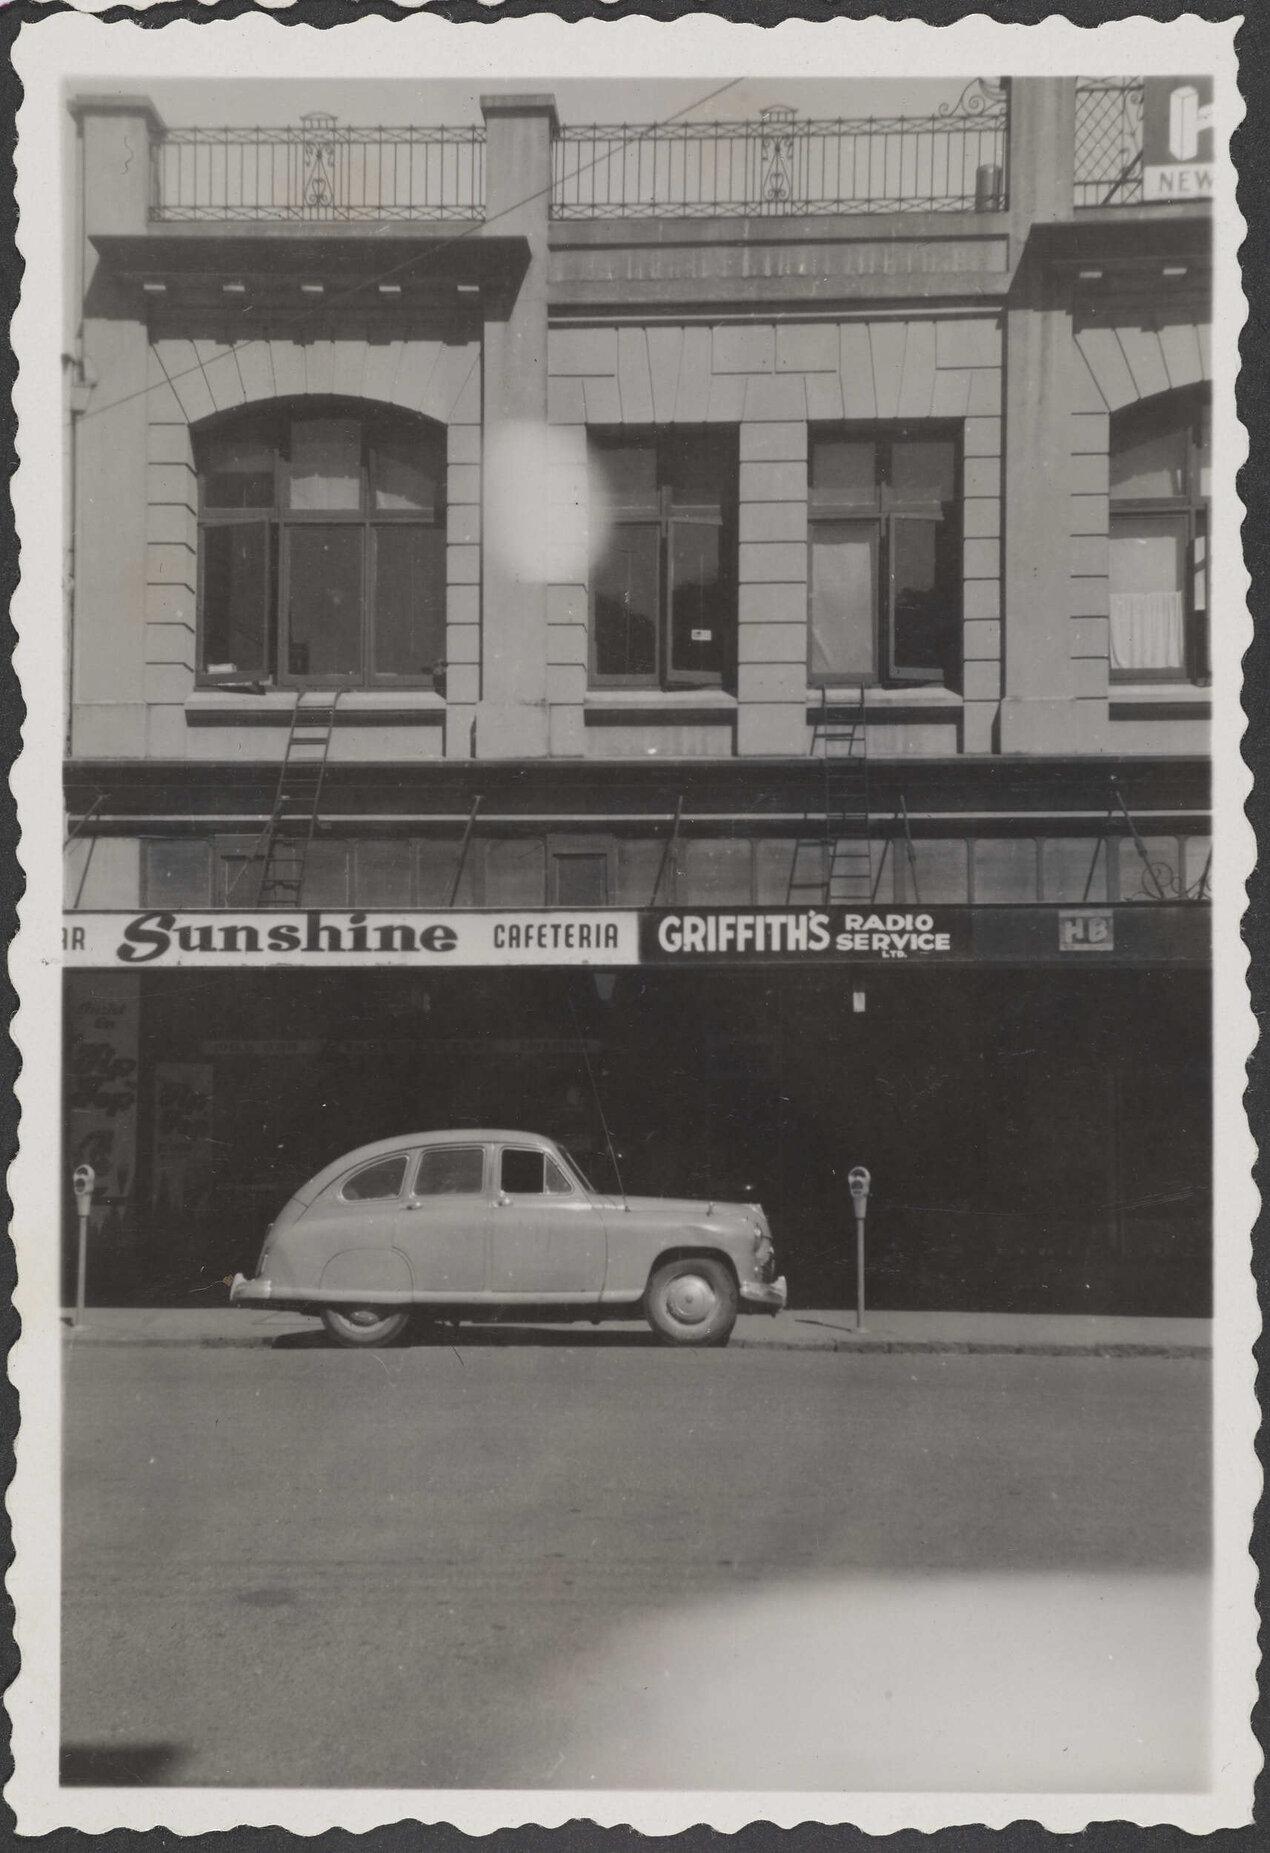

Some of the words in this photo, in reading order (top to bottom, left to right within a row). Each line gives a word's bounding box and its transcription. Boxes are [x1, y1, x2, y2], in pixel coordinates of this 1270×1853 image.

[116, 910, 458, 962] Sunshine
[493, 923, 618, 949] CAFETERIA
[658, 909, 831, 952] GRIFFITH'S
[845, 913, 934, 931] RADIO
[836, 933, 951, 951] SERVICE
